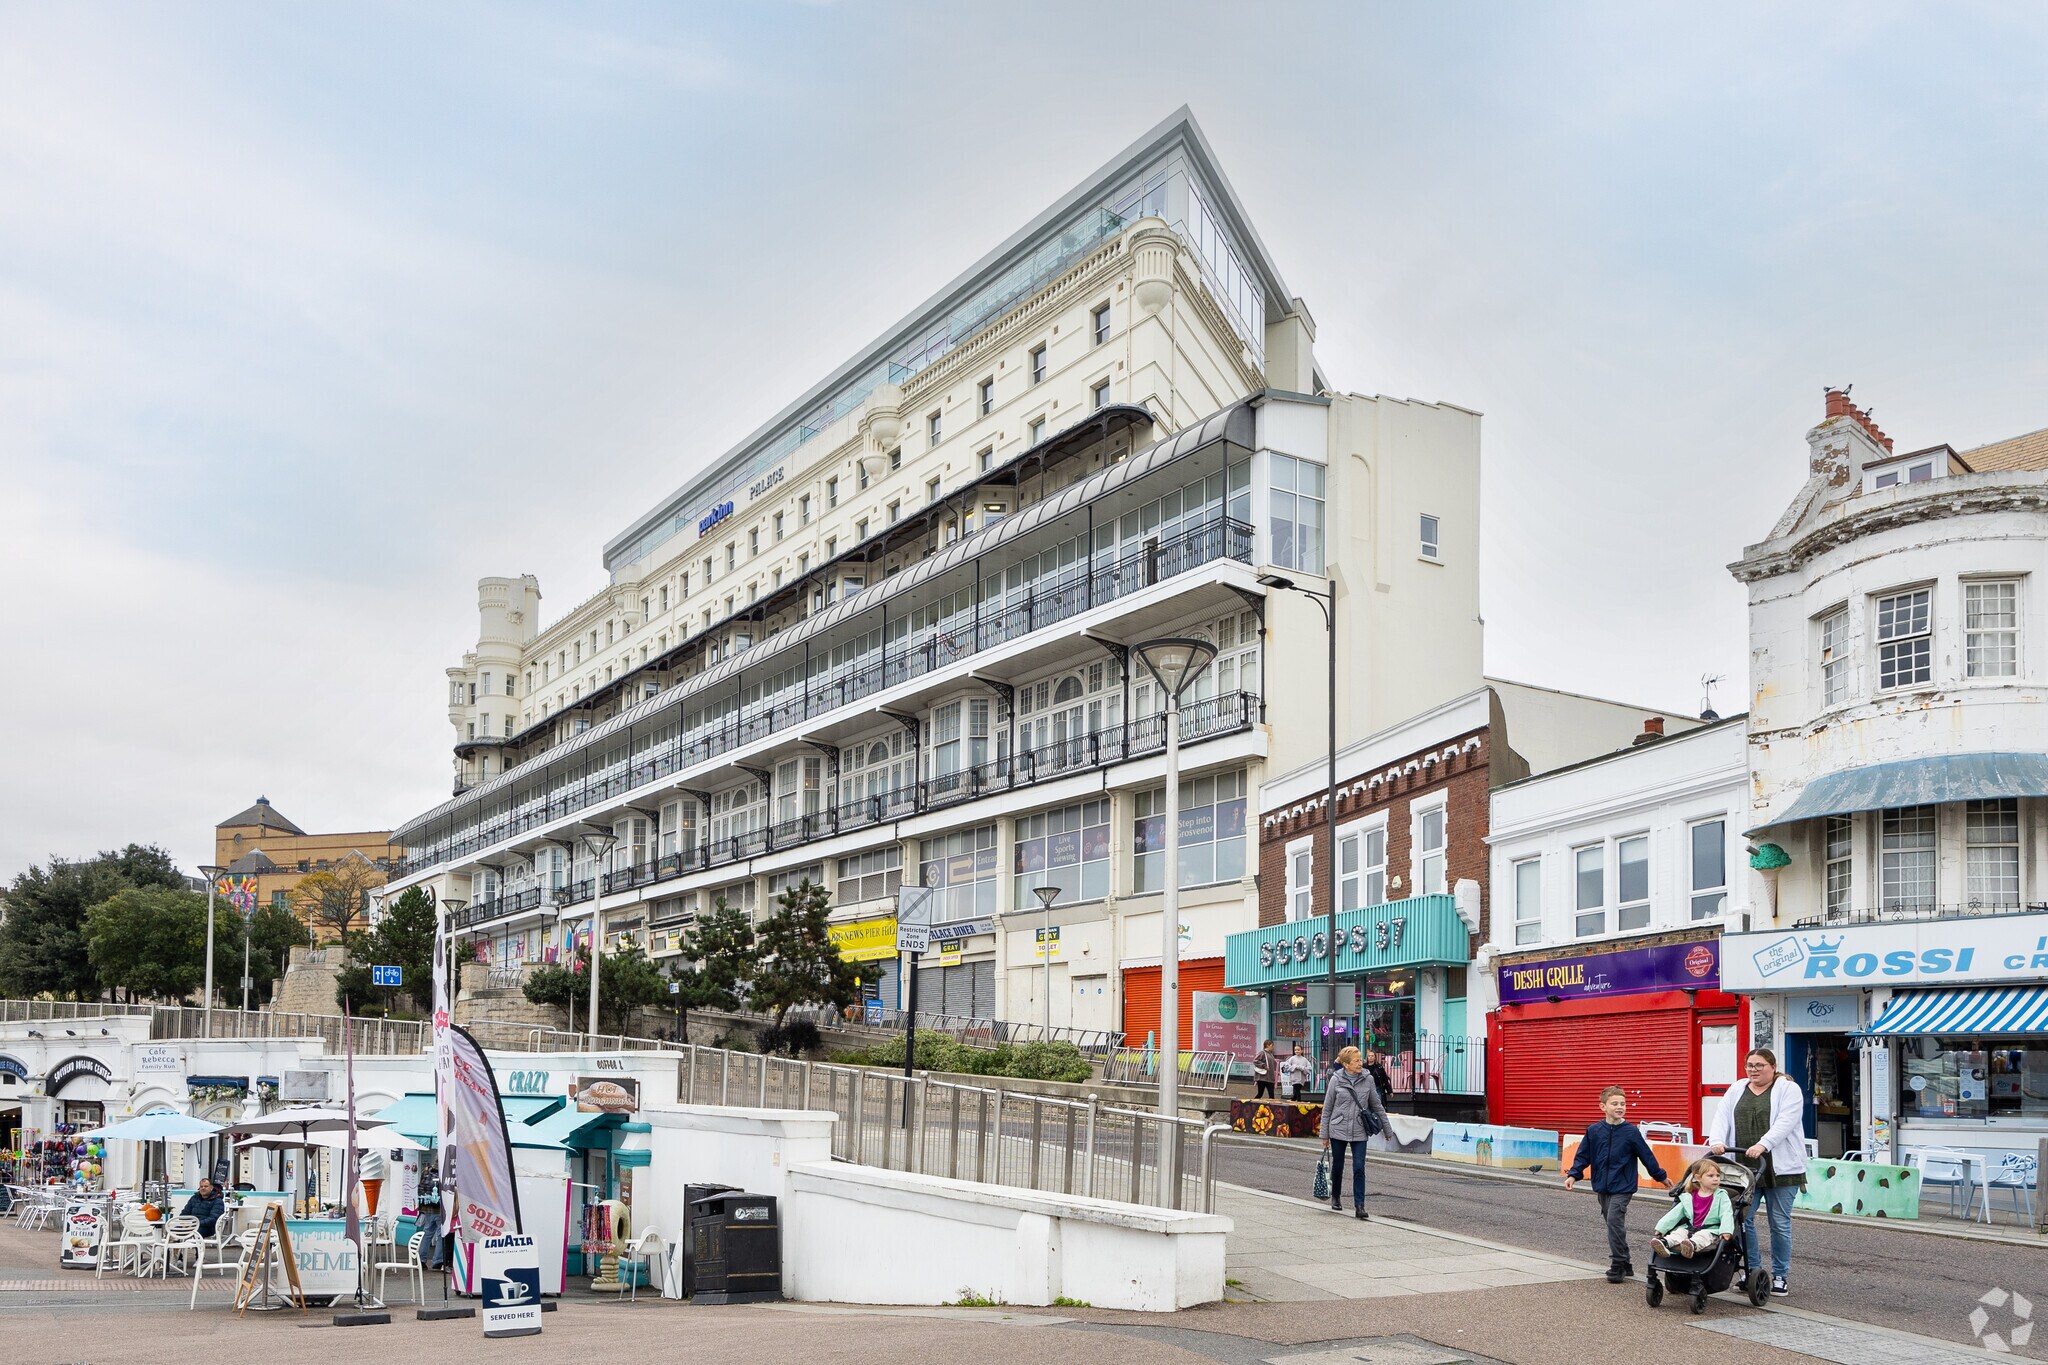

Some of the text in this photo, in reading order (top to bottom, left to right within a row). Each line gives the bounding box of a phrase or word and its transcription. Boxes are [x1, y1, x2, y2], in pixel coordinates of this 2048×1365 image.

[749, 466, 785, 500] PALACE
[1177, 815, 1212, 830] Step into
[1058, 836, 1071, 845] Live
[1054, 844, 1075, 856] Sports
[1053, 853, 1077, 863] viewing
[844, 929, 864, 941] NEWS
[866, 927, 881, 938] PIER
[900, 926, 928, 934] Restricted
[953, 924, 977, 937] DINER
[900, 940, 925, 949] ENDS
[1260, 917, 1407, 967] SCOOPS 37
[1769, 945, 1784, 958] the
[1689, 956, 1709, 966] Original
[1763, 948, 1798, 971] original
[1803, 947, 1975, 979] ROSSI
[1503, 964, 1585, 991] the DESHI GRILLE
[1583, 973, 1612, 993] adventure
[141, 1055, 176, 1064] Rebecca
[149, 1048, 167, 1056] Cafe
[54, 1061, 75, 1083] SOUTHEND
[94, 1063, 112, 1081] CENTRE
[454, 1055, 473, 1075] CE
[455, 1069, 488, 1097] REAM
[508, 1070, 550, 1093] CRAZY
[596, 1085, 618, 1094] HOT
[466, 1203, 506, 1229] SOLD
[471, 1219, 503, 1237] HER
[484, 1234, 534, 1249] LAVAZZA
[490, 1311, 535, 1322] SERVED HERE
